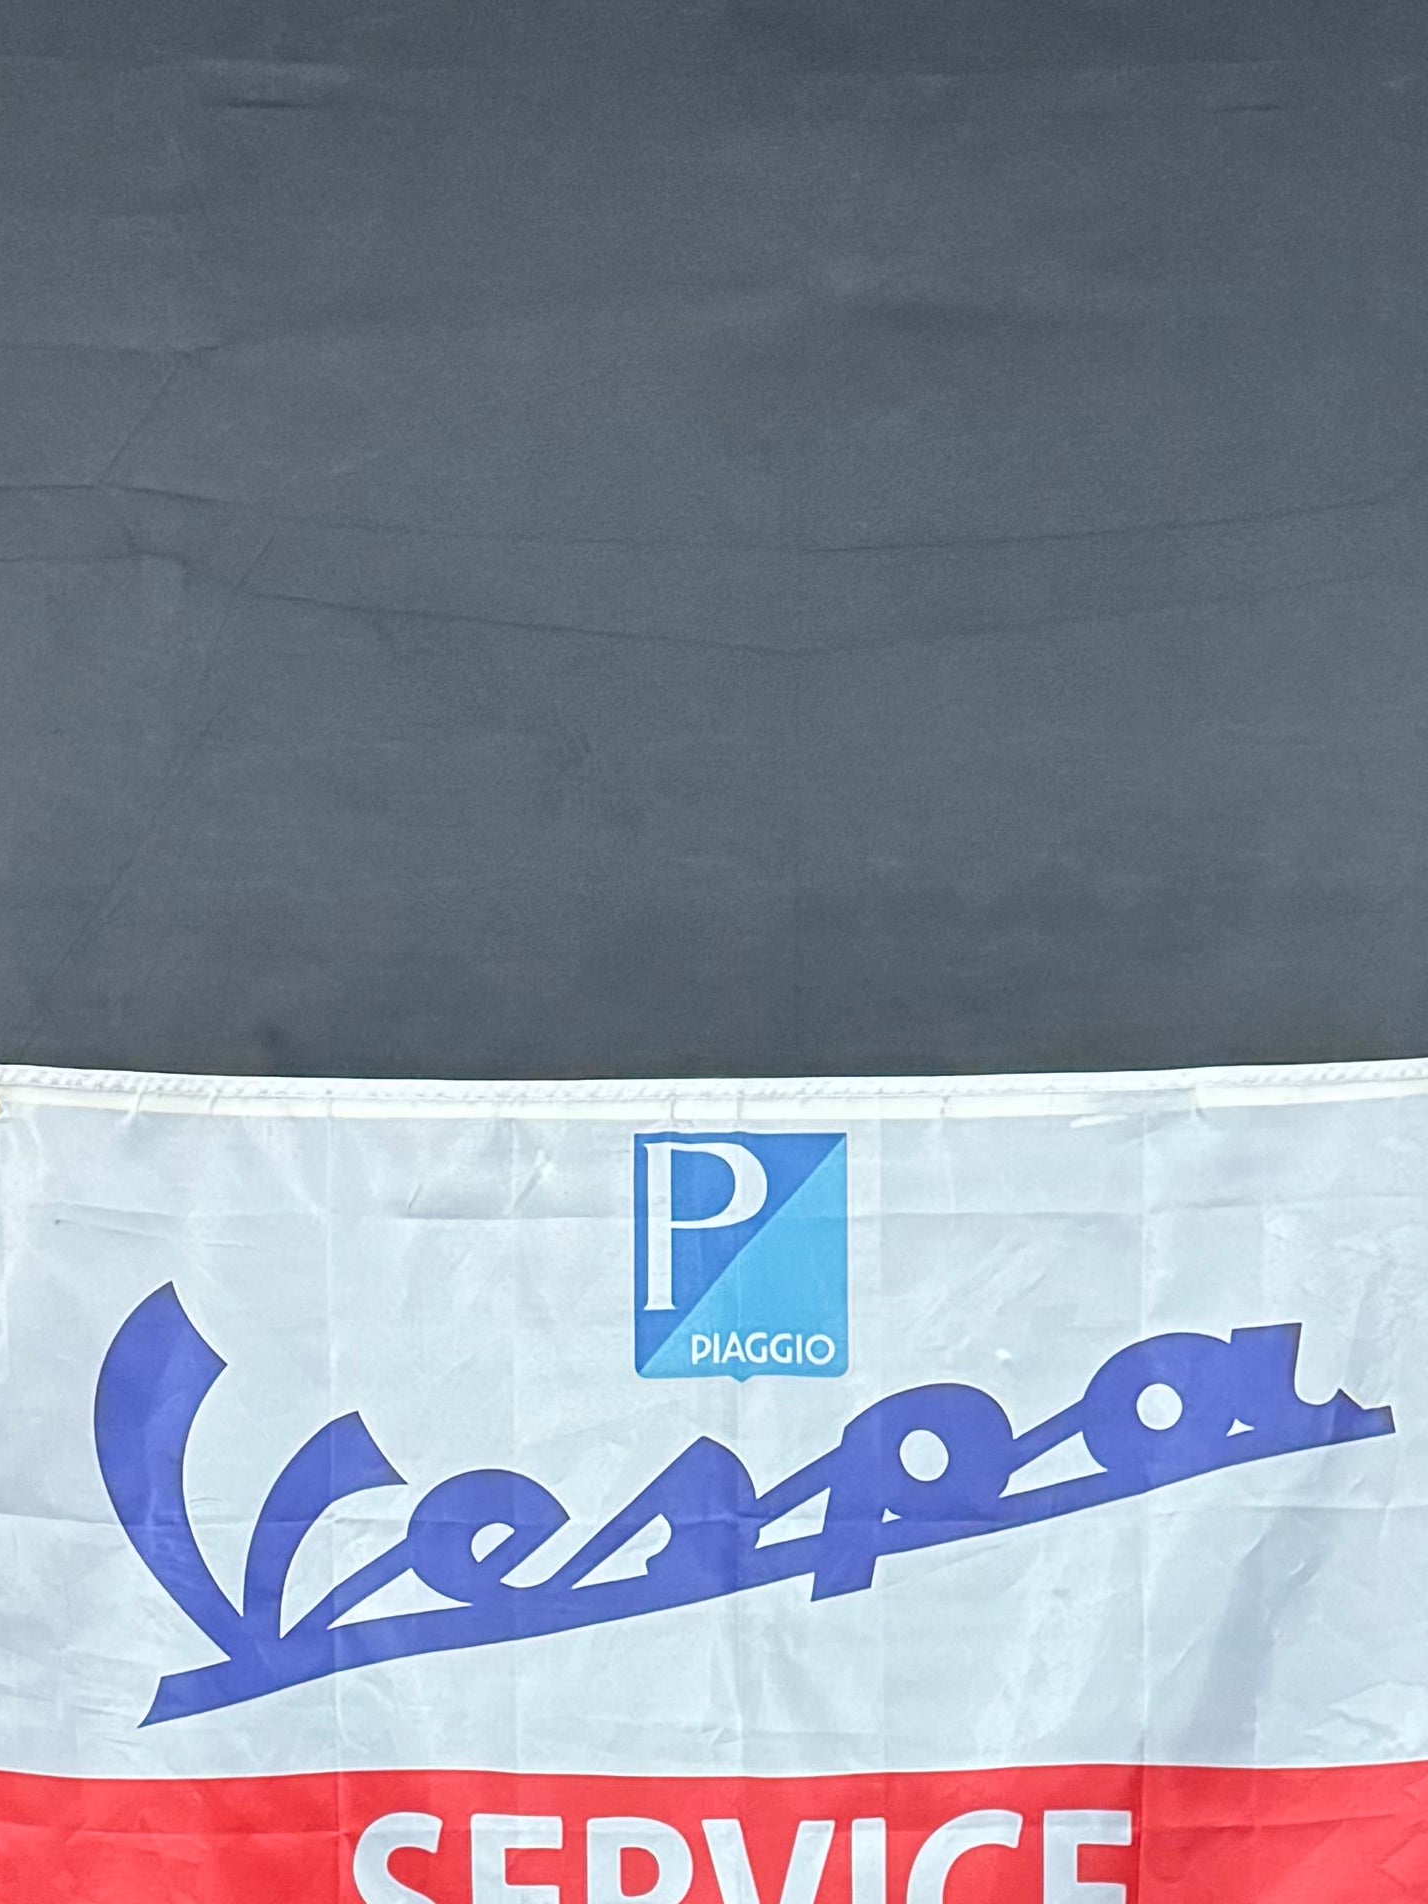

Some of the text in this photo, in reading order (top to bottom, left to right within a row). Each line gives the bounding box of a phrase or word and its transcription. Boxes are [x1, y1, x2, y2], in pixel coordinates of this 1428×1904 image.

[643, 1141, 768, 1311] P
[690, 1331, 836, 1366] PIAGGIO
[93, 1281, 1395, 1729] Vespa
